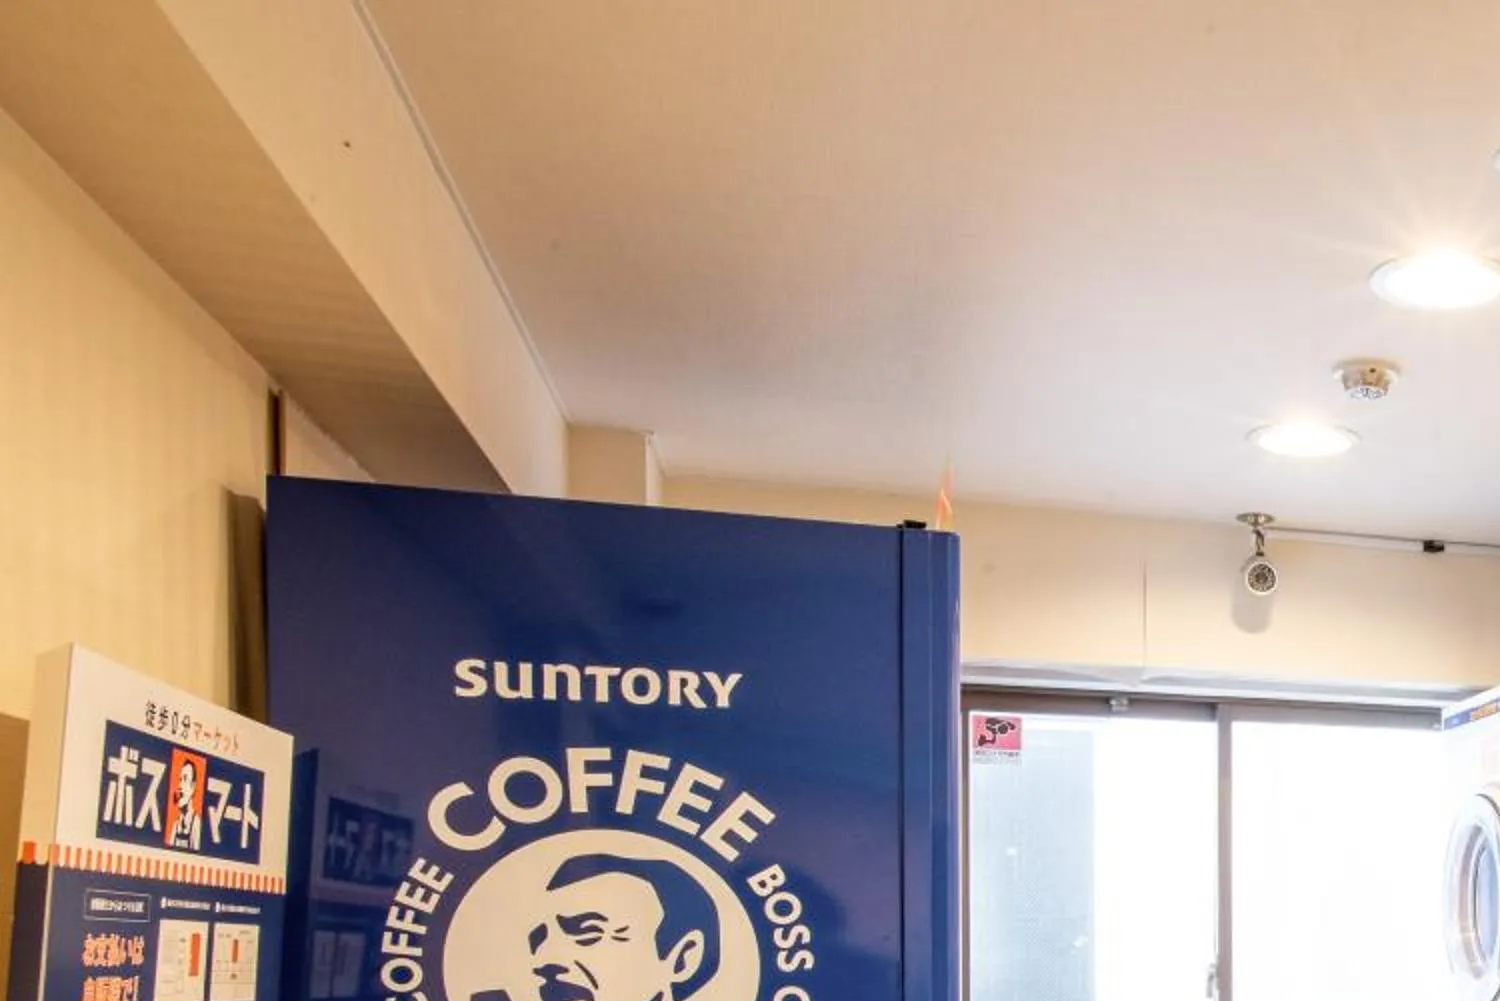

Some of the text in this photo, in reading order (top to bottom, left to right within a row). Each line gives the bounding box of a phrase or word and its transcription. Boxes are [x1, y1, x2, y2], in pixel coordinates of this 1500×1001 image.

[455, 658, 744, 709] SUNTORY
[103, 745, 259, 849] ボス マート
[427, 747, 776, 862] COFFEE
[747, 864, 816, 974] BOSS
